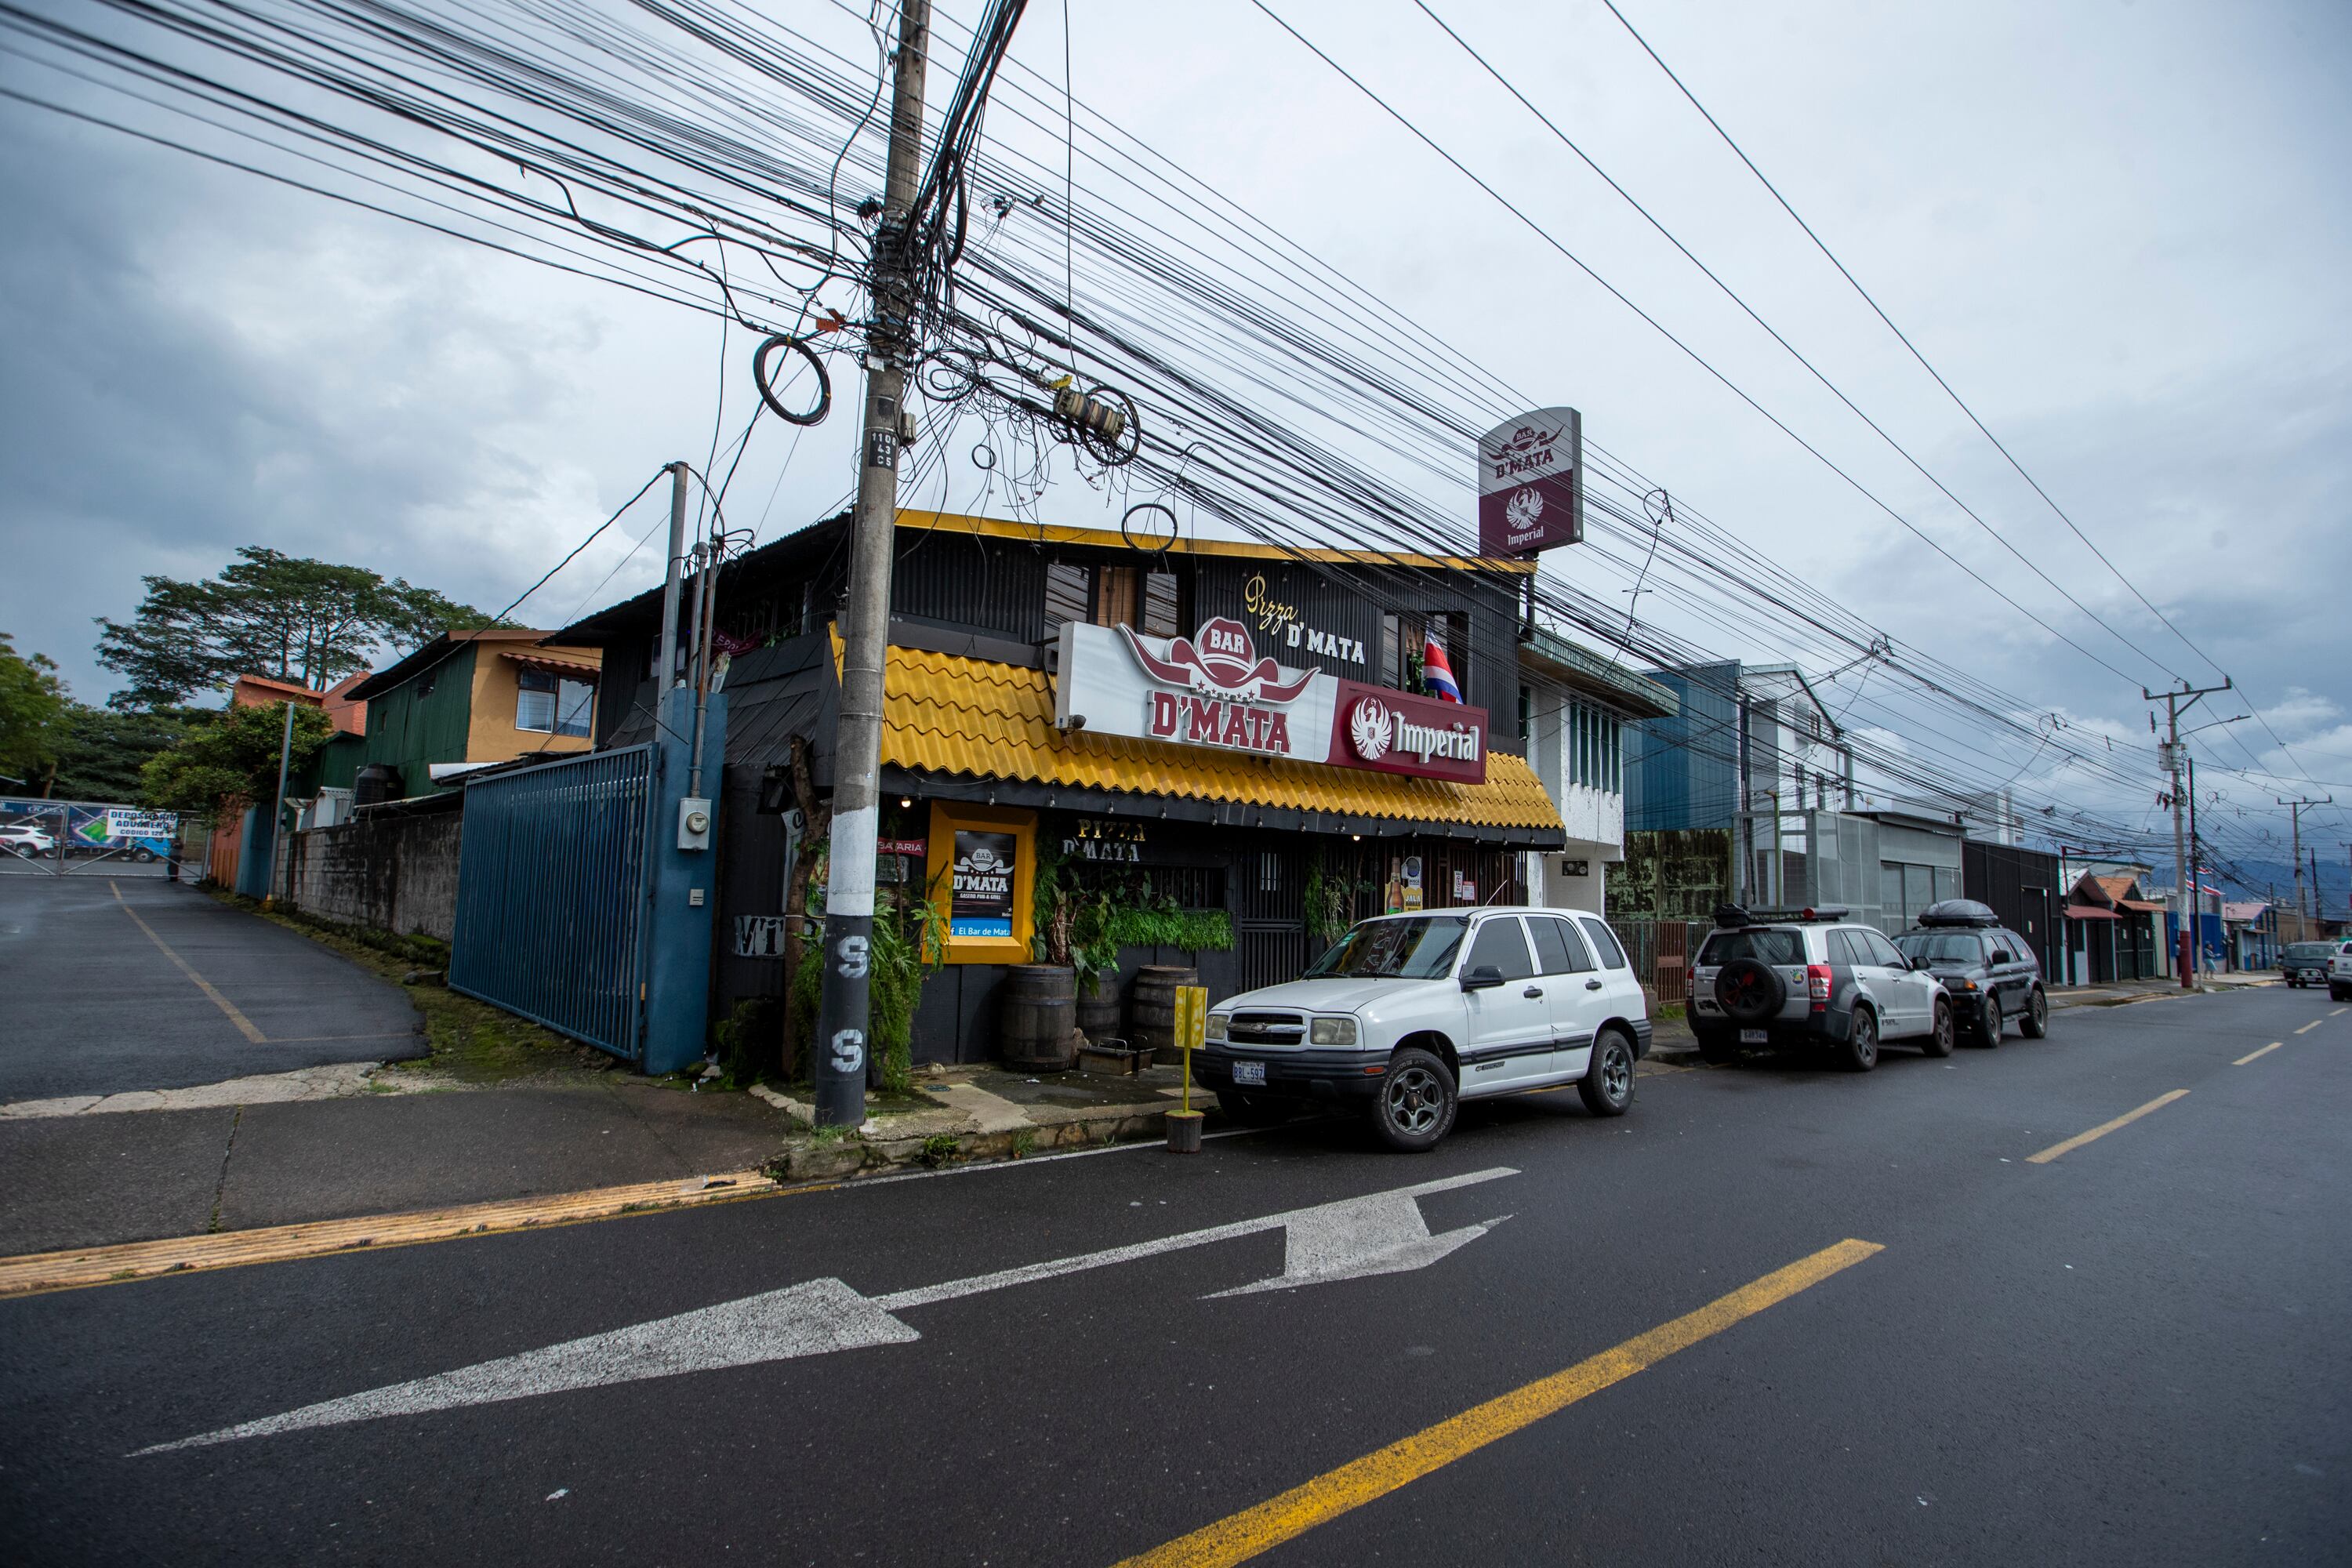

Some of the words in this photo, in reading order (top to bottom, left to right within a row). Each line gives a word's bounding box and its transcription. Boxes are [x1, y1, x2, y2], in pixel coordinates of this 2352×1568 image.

[877, 444, 891, 455] 43
[1516, 430, 1533, 441] BAR
[877, 455, 892, 466] C5
[1496, 448, 1554, 479] D'MATA
[1508, 526, 1544, 546] Imperial
[1245, 571, 1298, 636] Pizza
[1210, 628, 1245, 655] BAR
[1287, 622, 1365, 665] D'MATA
[1149, 690, 1291, 755] D'MATA
[1391, 711, 1479, 764] Imperial
[953, 875, 1008, 892] D'MATA
[838, 936, 869, 978] S
[831, 1029, 863, 1073] S
